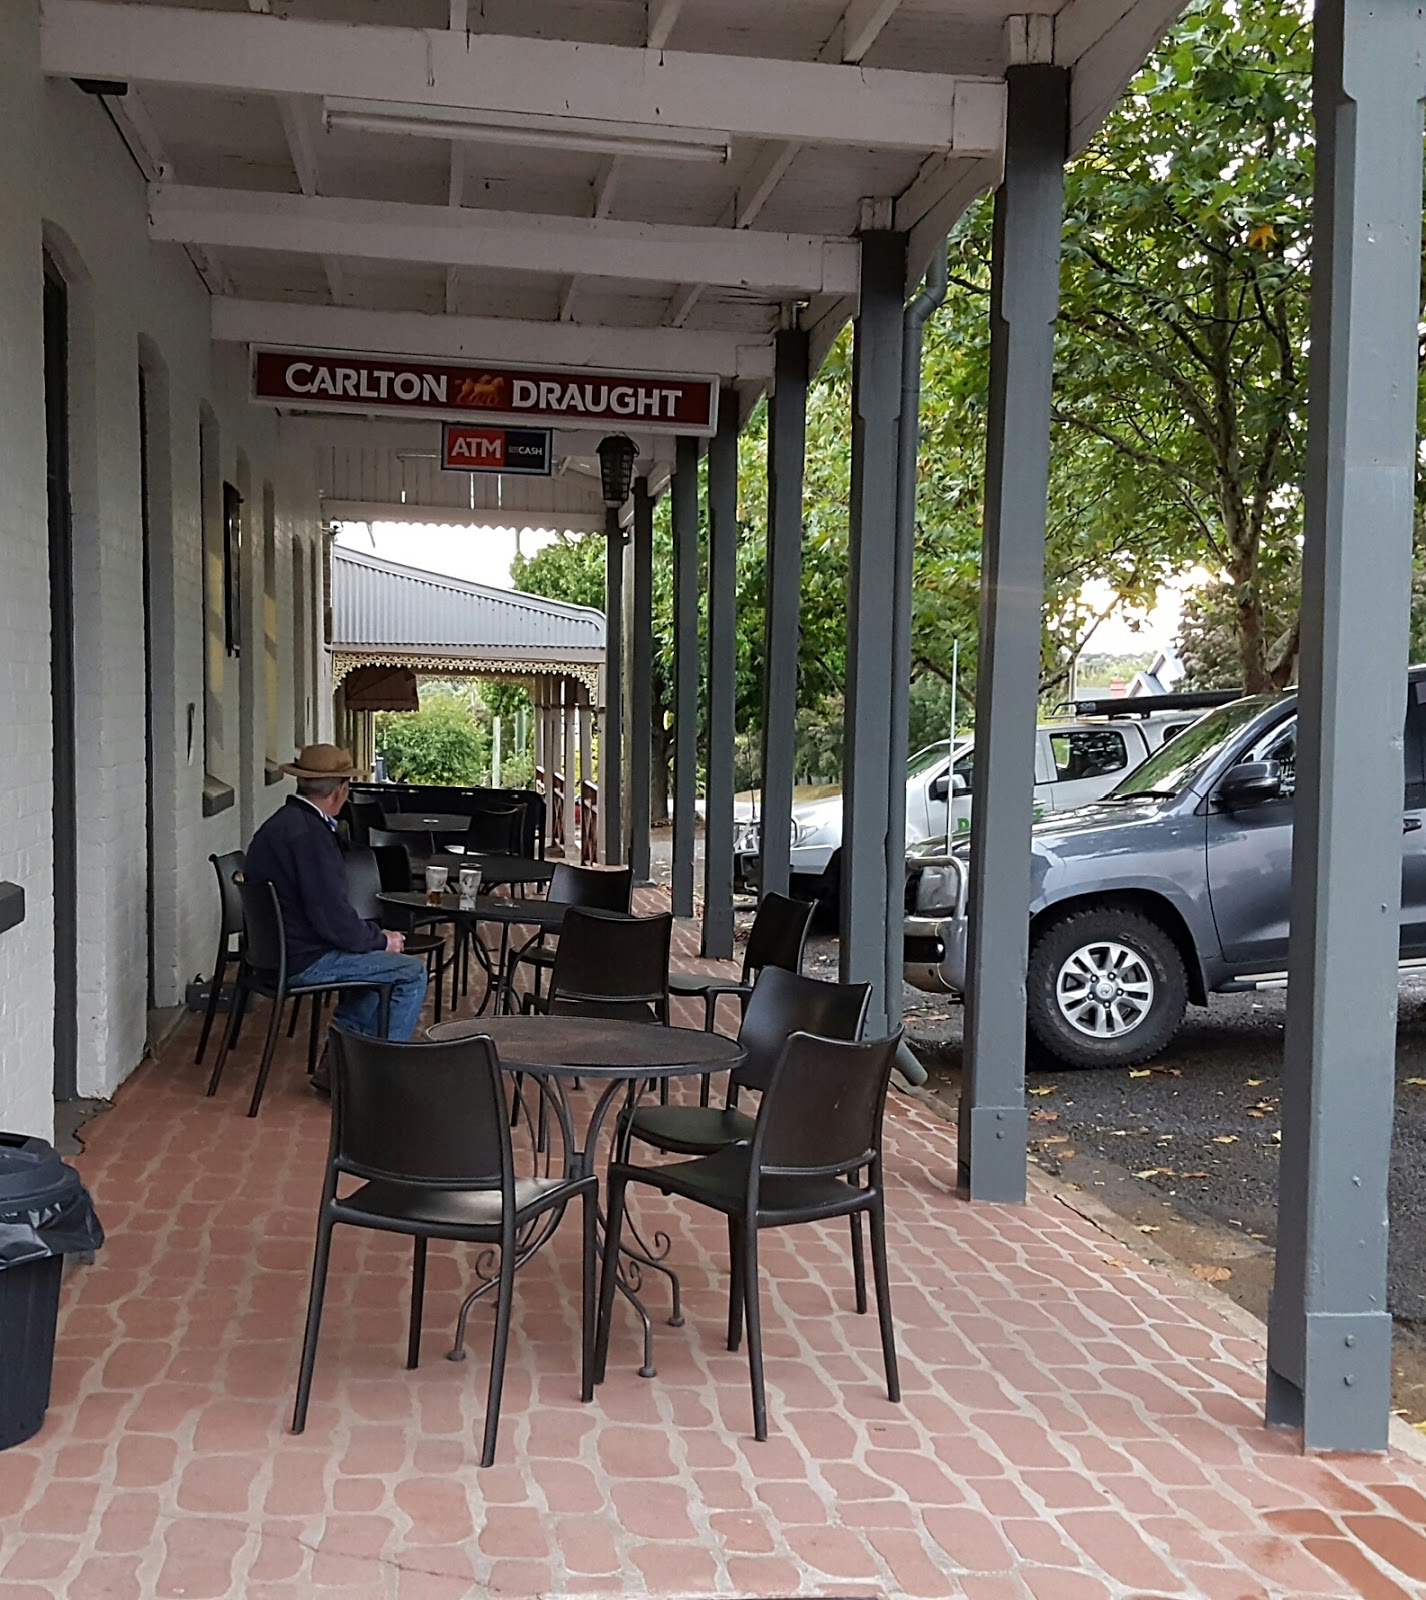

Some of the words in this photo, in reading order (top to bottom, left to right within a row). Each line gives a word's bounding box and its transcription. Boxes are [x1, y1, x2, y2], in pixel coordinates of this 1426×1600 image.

[285, 362, 448, 402] CARLTON
[512, 379, 683, 417] DRAUGHT
[451, 437, 501, 458] ATM
